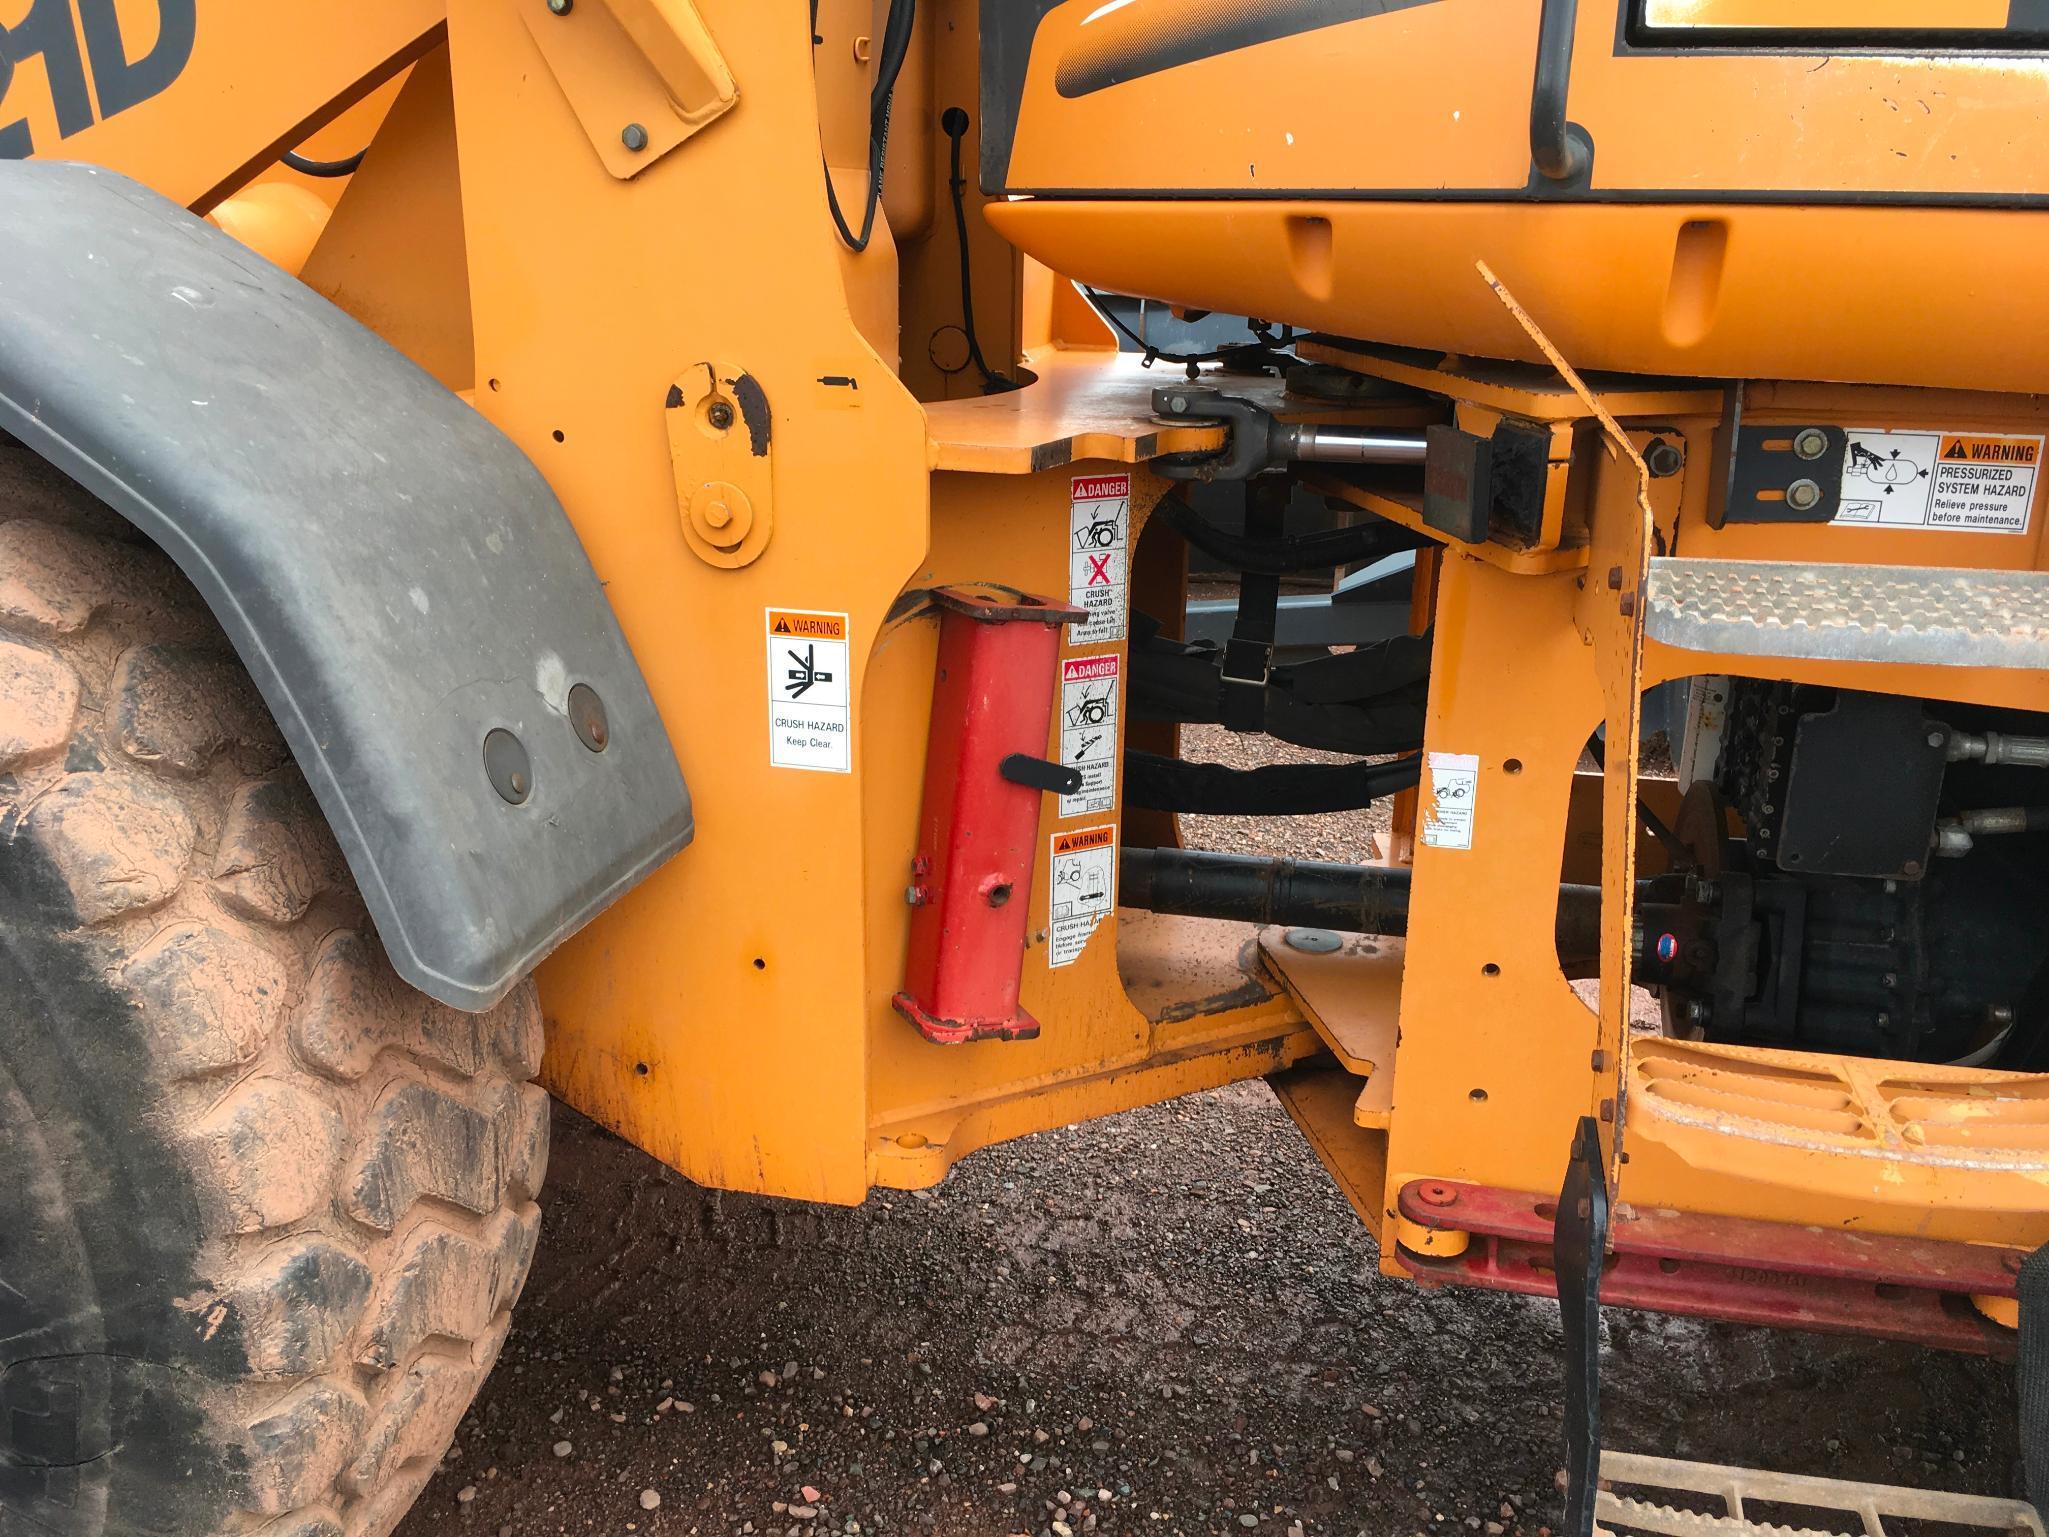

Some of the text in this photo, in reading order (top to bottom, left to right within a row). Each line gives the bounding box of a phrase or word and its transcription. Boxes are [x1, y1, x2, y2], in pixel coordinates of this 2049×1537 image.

[1971, 444, 2034, 461] WARNING
[1940, 467, 2013, 481] PRESSURIZED
[1088, 481, 1127, 497] DANGER
[1938, 482, 2026, 497] SYSTEM HAZARD
[1935, 499, 2008, 512] Relieve pressure
[1932, 512, 2022, 526] before maintenance.
[1086, 589, 1110, 599] CRUSH
[1084, 598, 1113, 608] HAZARD
[793, 619, 840, 636] WARNING
[1078, 661, 1116, 678] DANGER
[775, 717, 845, 733] CRUSH HAZARD
[786, 736, 833, 749] Keep Clear.
[1086, 762, 1109, 771] HAZARD
[1071, 831, 1108, 848] WARNING
[1056, 923, 1079, 932] CRUSH
